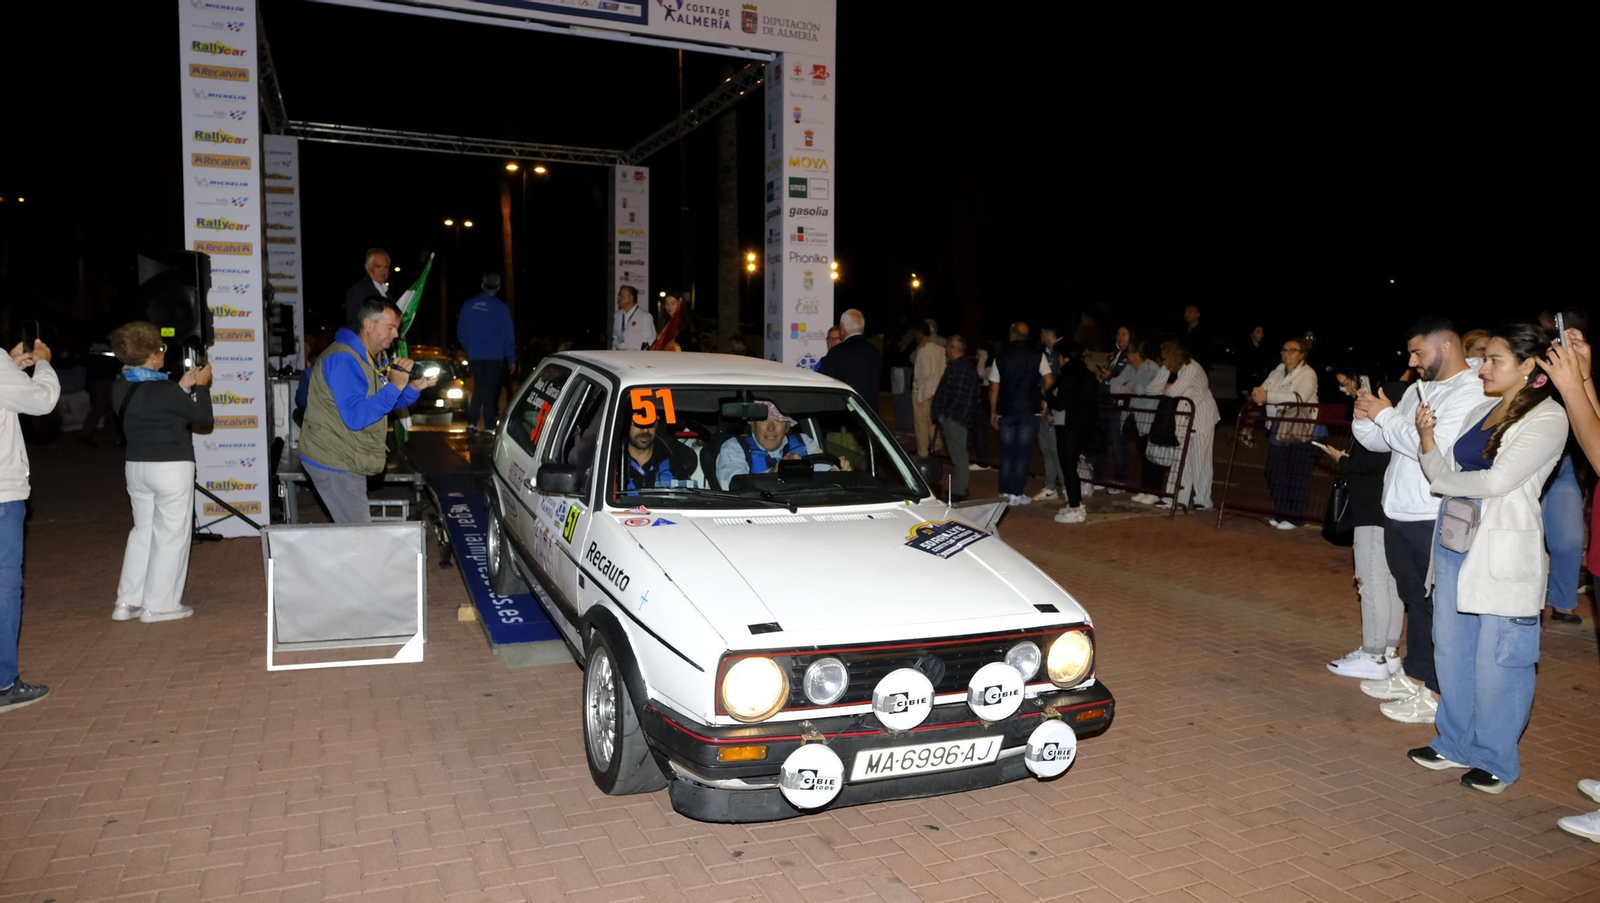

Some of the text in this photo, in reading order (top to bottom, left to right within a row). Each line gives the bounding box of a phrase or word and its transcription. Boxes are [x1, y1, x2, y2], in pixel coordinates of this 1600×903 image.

[686, 3, 730, 17] COSTA DE
[676, 13, 731, 31] ALMERÍA
[762, 16, 821, 32] DIPUTACIÓN
[762, 26, 818, 42] DE ALMERÍA
[192, 40, 247, 56] Rallycar
[201, 66, 237, 78] Recalvi
[194, 130, 249, 145] Rallycar
[203, 156, 240, 167] Recalvi
[788, 156, 829, 169] MOYA
[789, 206, 828, 218] gasolia
[196, 217, 250, 231] Rallycar
[205, 244, 241, 253] Recalvi
[789, 250, 828, 264] Phonika
[214, 332, 244, 340] ecalvi
[212, 394, 256, 404] allycar
[630, 388, 677, 425] 51
[206, 480, 259, 491] Rallycar
[564, 505, 581, 541] 51
[931, 525, 966, 545] RALLYE
[585, 540, 630, 592] Recauto
